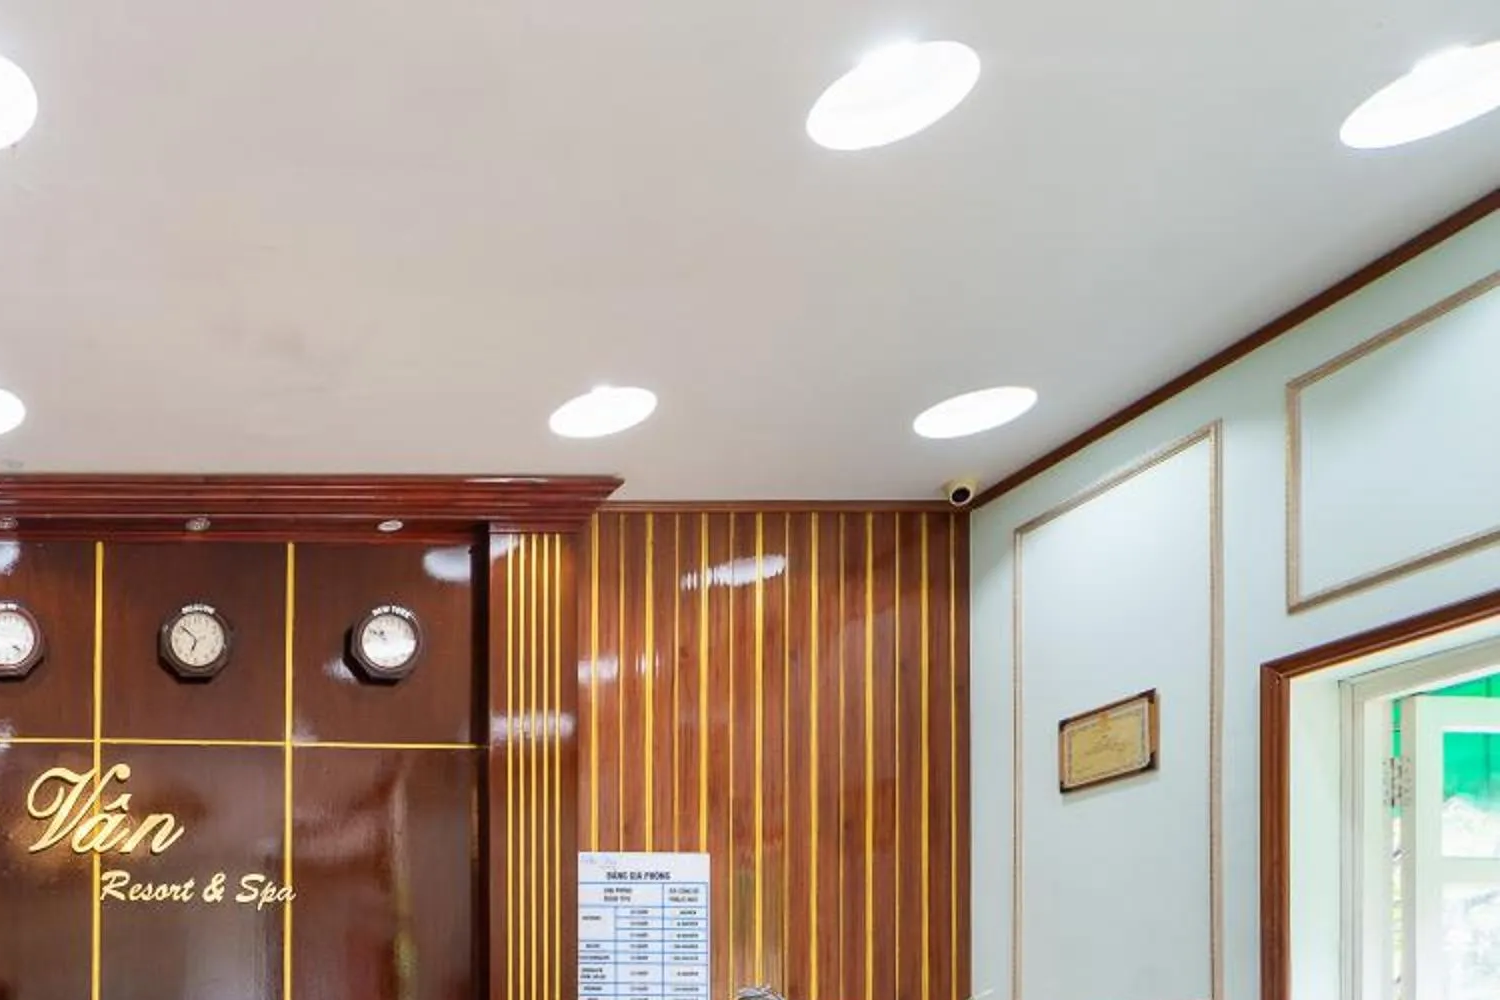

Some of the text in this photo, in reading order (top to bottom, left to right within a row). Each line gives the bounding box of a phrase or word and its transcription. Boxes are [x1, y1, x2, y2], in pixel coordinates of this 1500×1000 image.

[28, 763, 184, 856] Vân
[100, 871, 296, 909] Resort & Spa
